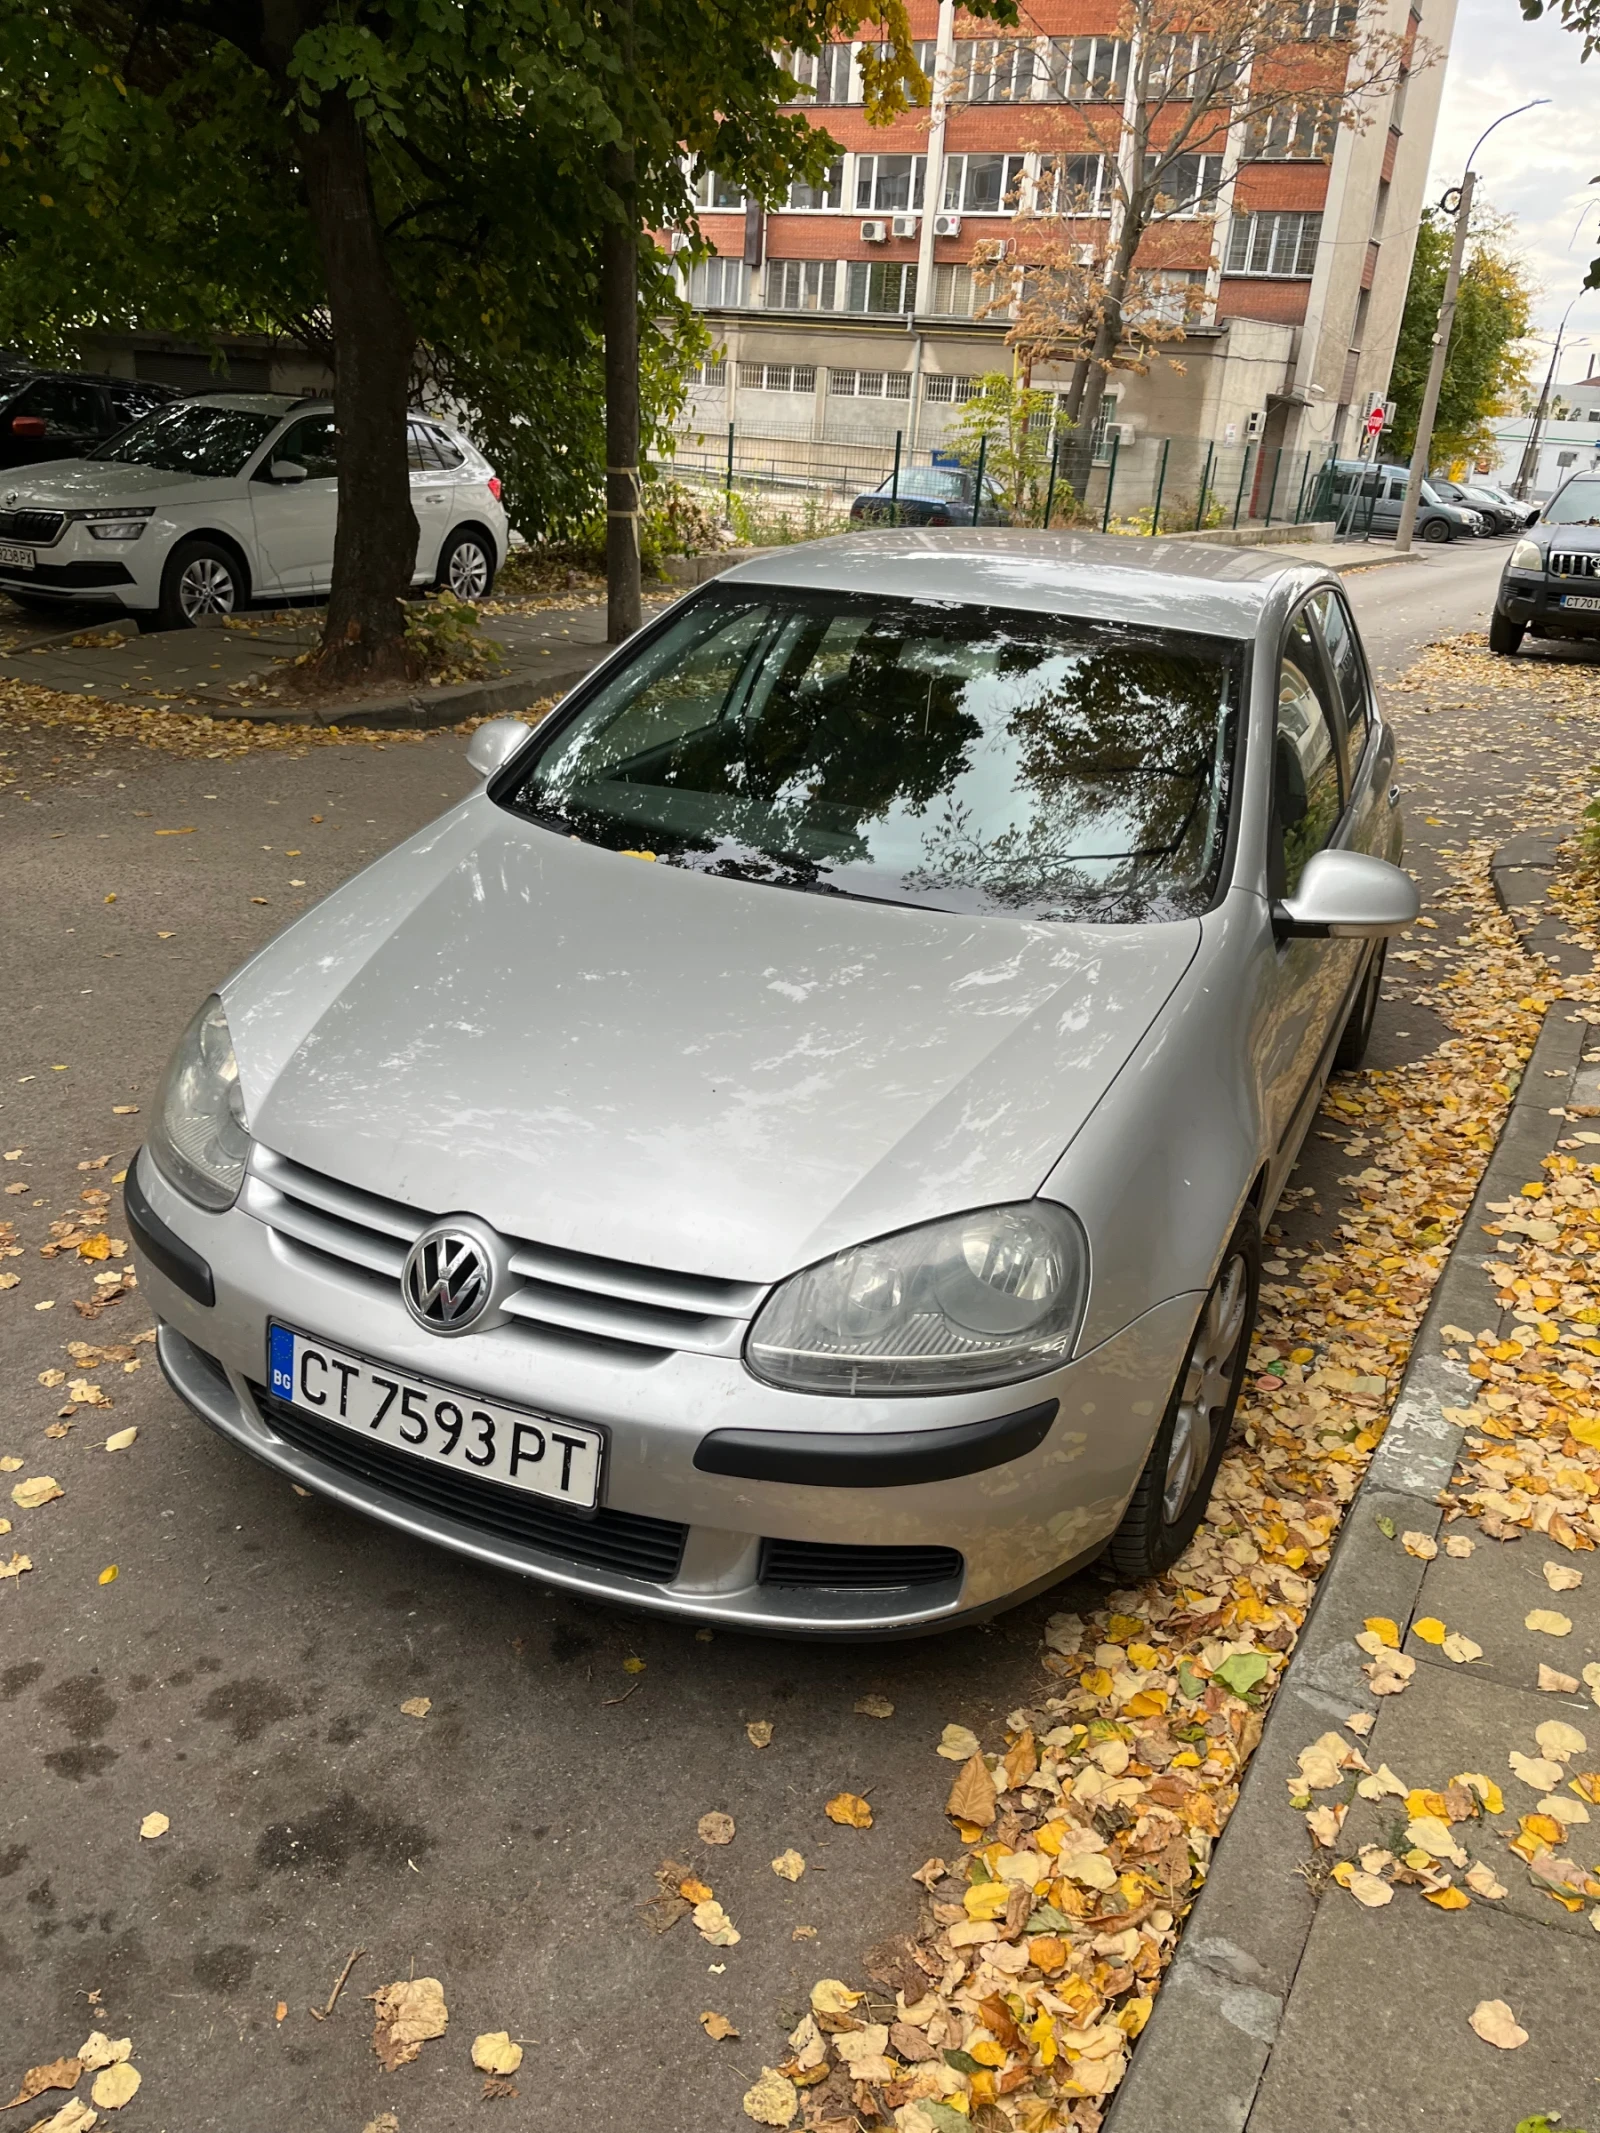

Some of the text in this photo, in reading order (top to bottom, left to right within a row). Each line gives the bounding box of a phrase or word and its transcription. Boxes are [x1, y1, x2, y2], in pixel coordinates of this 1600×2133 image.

[1368, 416, 1383, 427] STOP
[1580, 598, 1600, 609] 701
[273, 1368, 292, 1390] BG
